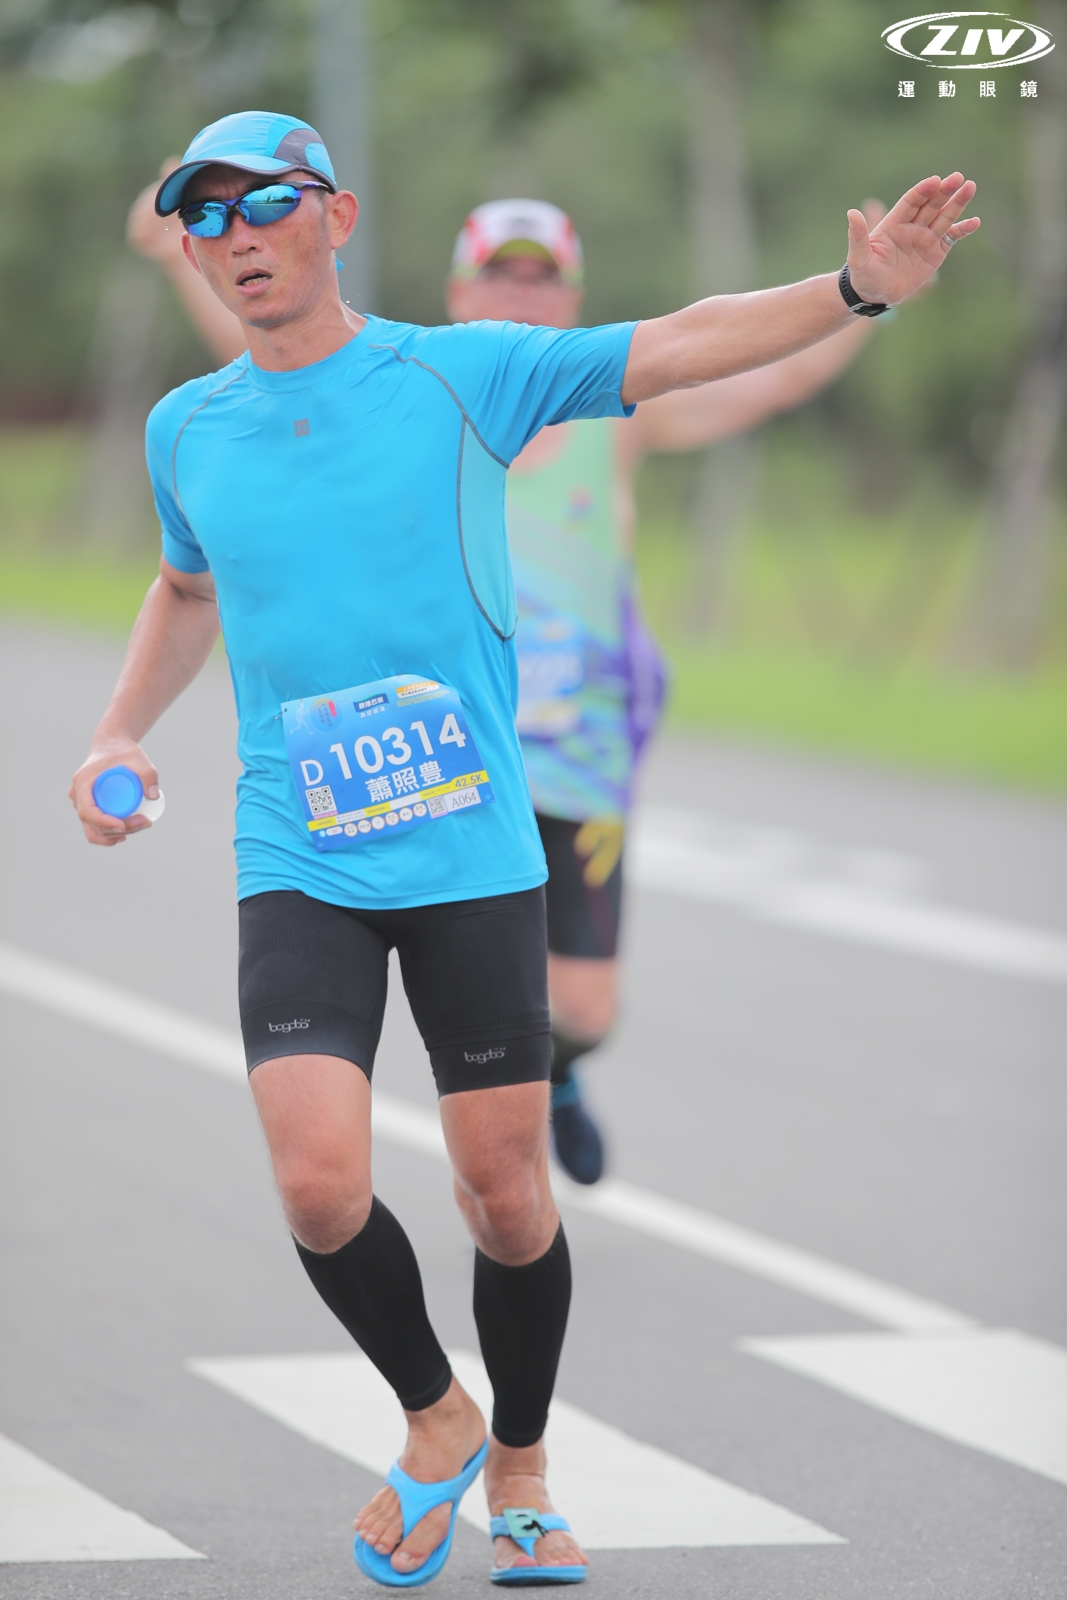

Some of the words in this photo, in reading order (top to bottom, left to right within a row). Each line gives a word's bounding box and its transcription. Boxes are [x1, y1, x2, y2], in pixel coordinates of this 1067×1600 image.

[300, 759, 324, 787] D
[329, 713, 467, 780] 10314
[364, 760, 446, 803] 蕭照豊
[455, 773, 484, 788] 42.5K
[452, 791, 478, 808] A064
